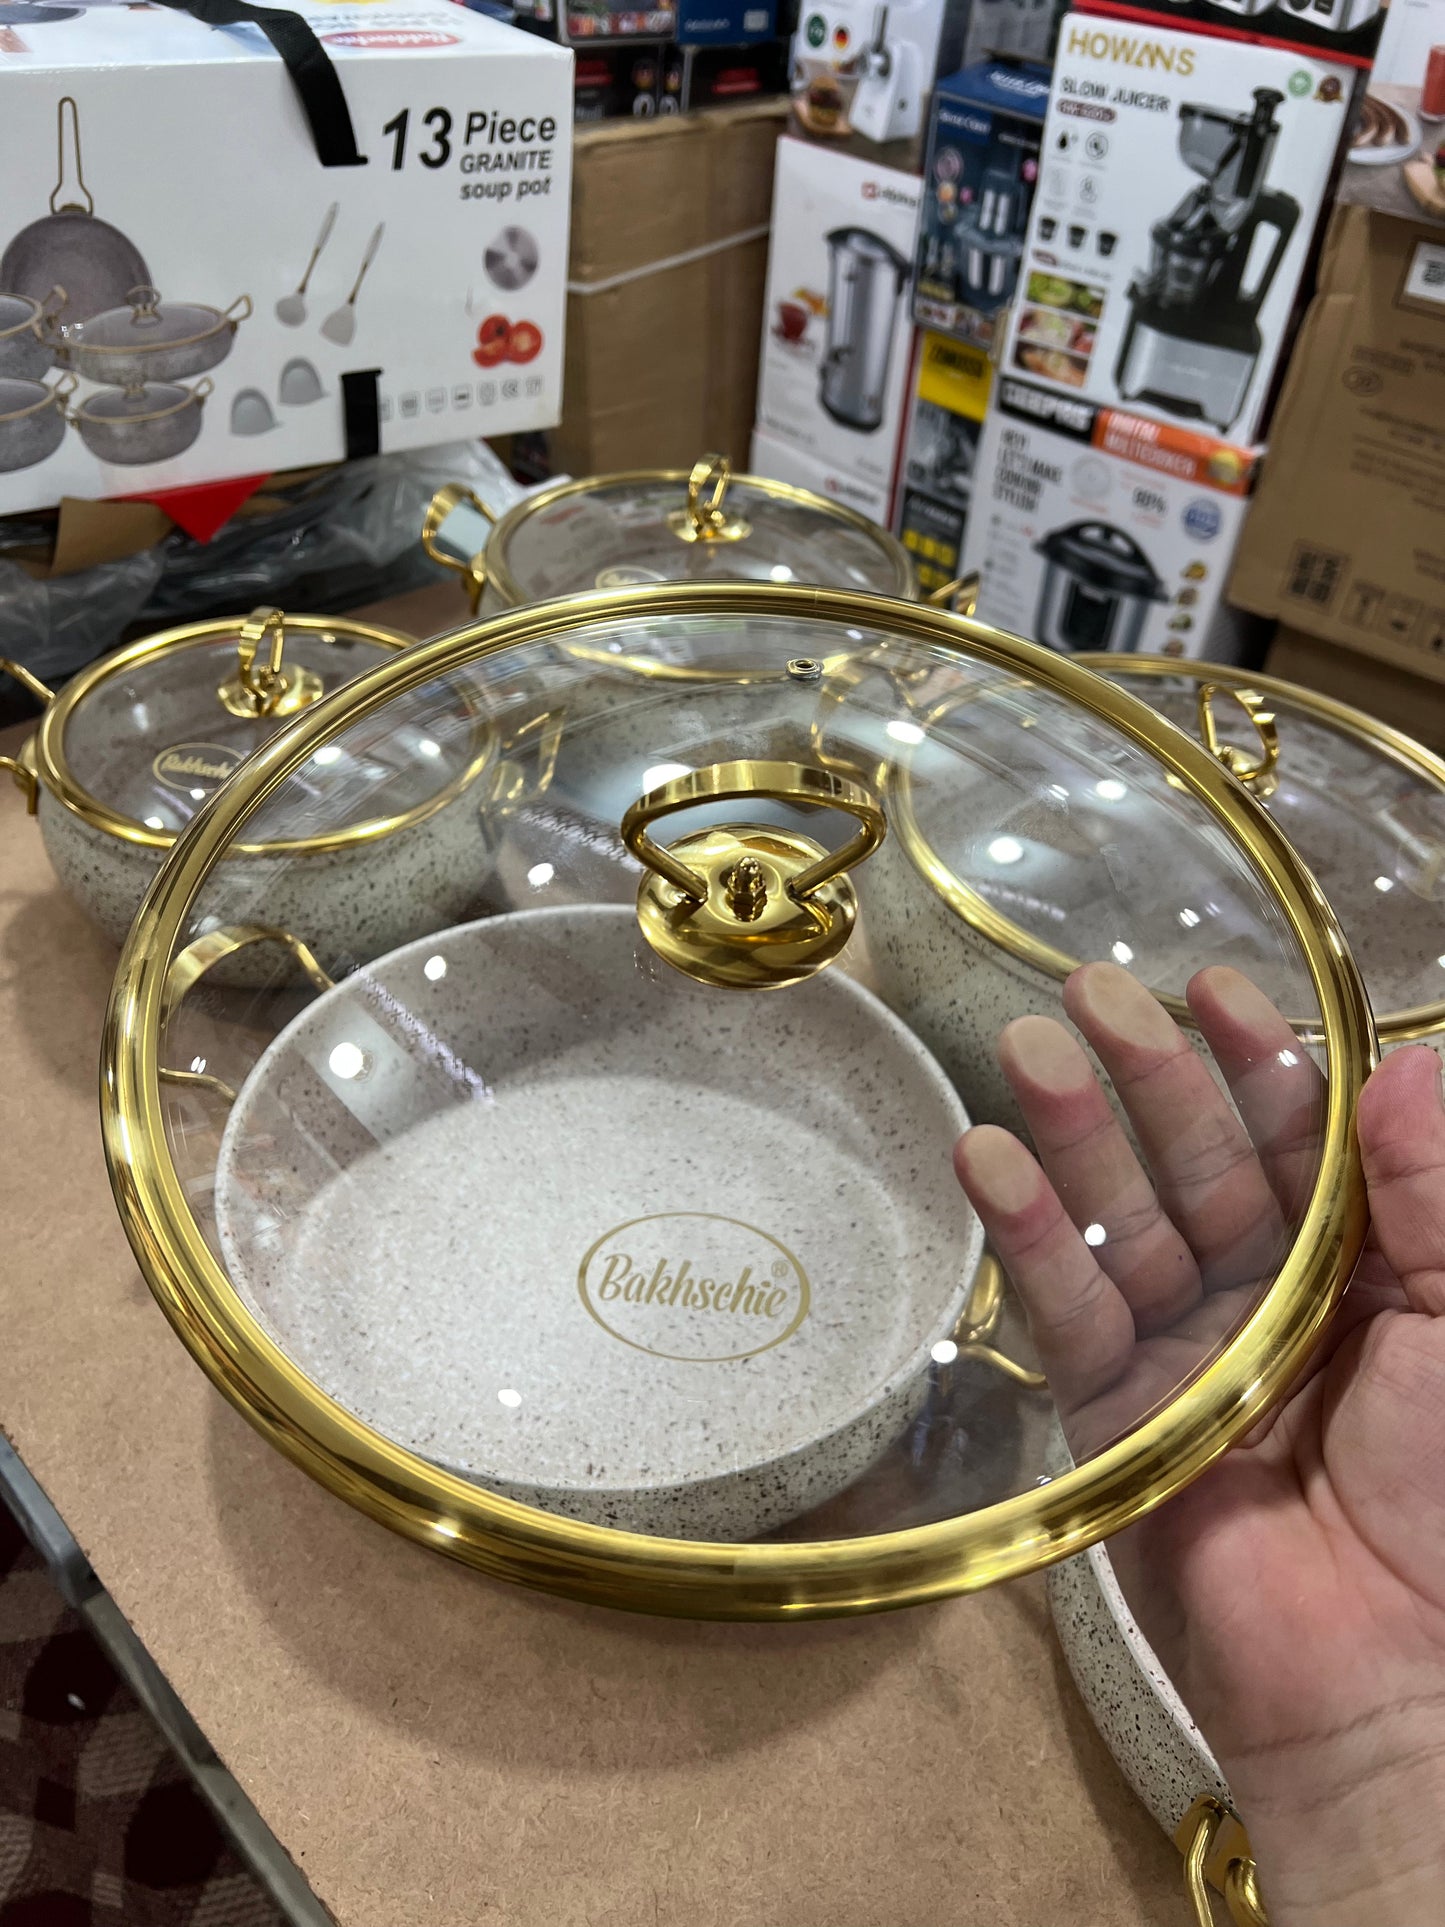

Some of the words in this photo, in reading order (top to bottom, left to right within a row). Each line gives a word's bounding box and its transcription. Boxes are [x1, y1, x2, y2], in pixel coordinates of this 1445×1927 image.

[1068, 28, 1197, 76] HOWANS
[382, 106, 453, 171] 13
[464, 111, 556, 145] Piece
[459, 150, 552, 174] GRANITE
[460, 181, 512, 203] soup
[516, 176, 552, 201] pot
